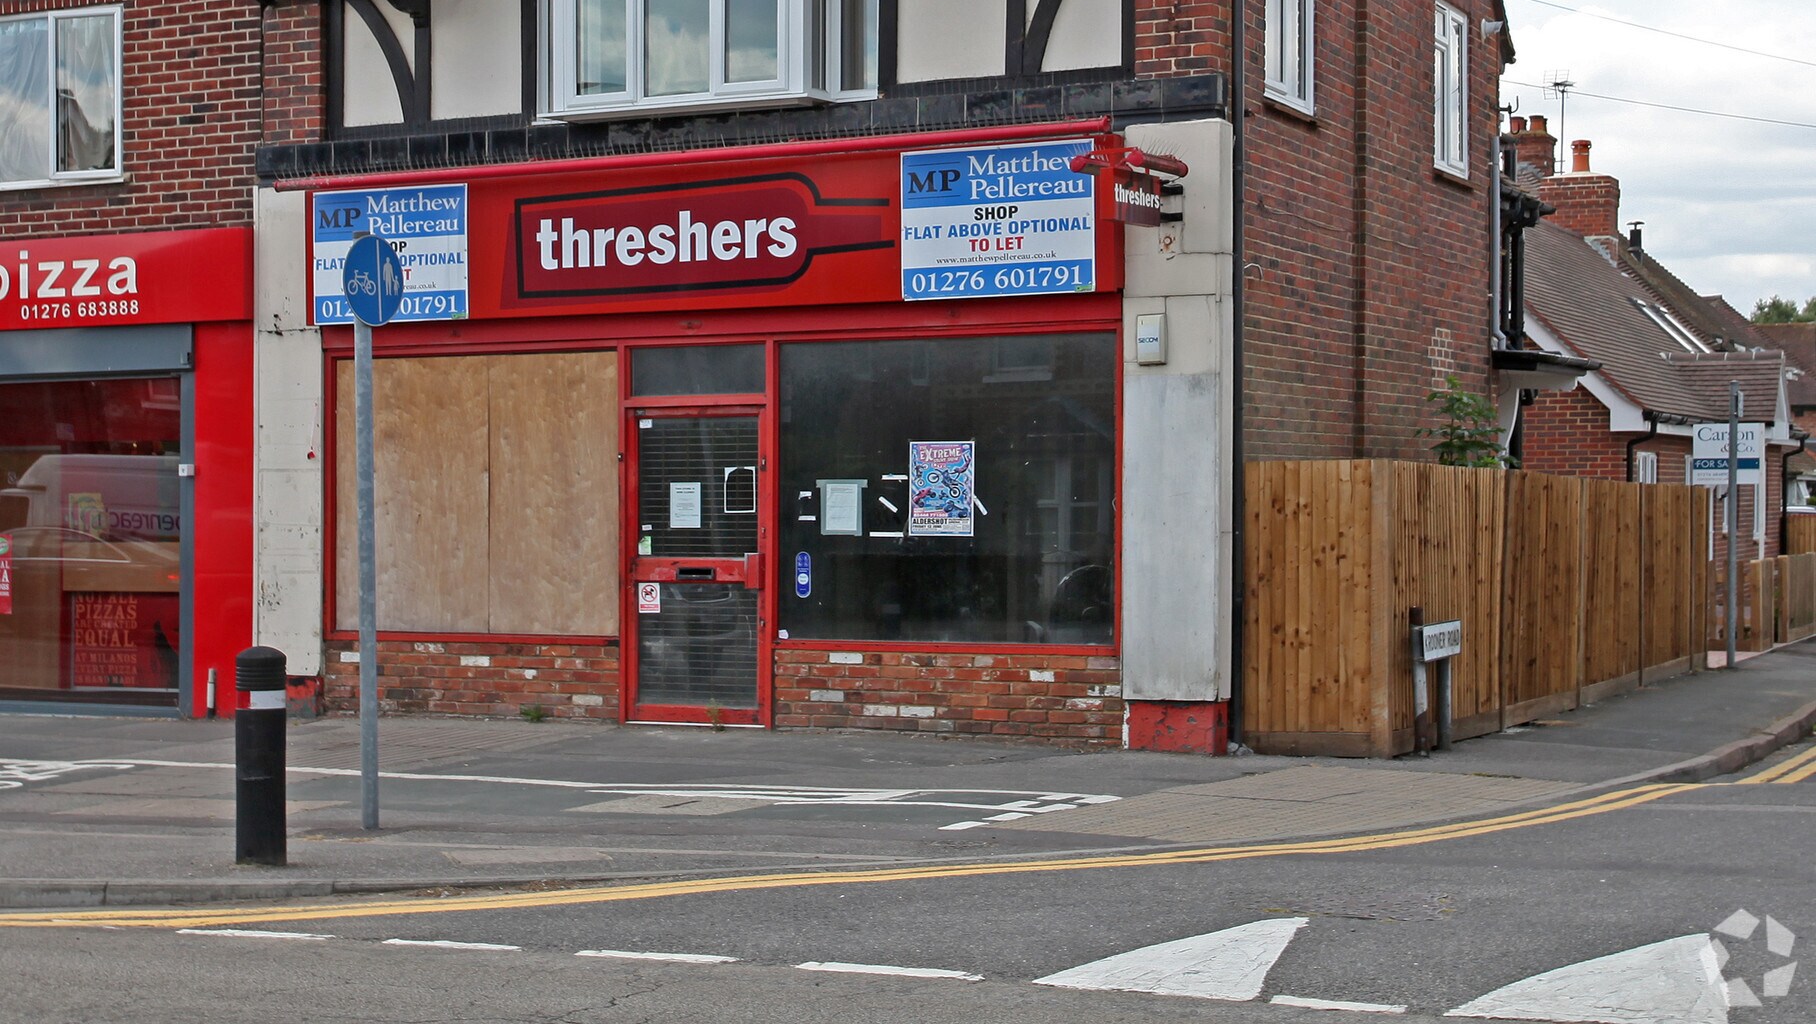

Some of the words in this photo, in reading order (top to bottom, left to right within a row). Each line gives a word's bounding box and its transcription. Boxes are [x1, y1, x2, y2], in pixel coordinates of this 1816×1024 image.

[907, 169, 961, 194] MP
[969, 176, 1086, 200] Pellereau
[366, 192, 461, 215] Matthew
[1114, 183, 1160, 209] threshers
[318, 207, 362, 229] MP
[974, 205, 1019, 221] SHOP
[369, 214, 459, 236] Pellereau
[904, 225, 942, 240] FLAT
[948, 221, 1001, 238] ABOVE
[1008, 216, 1091, 235] OPTIONAL
[536, 210, 797, 270] threshers
[969, 238, 990, 252] TO
[996, 236, 1024, 251] LET
[316, 257, 345, 271] FLAT
[401, 252, 464, 267] OPTIONAL
[936, 250, 1057, 265] www.matthewpellereau.co.uk
[912, 269, 985, 293] 01276
[995, 264, 1082, 289] 601791
[21, 303, 71, 320] 01276
[78, 299, 139, 318] 683888
[322, 299, 355, 318] 012
[400, 295, 458, 315] 01791
[1697, 426, 1755, 442] Caron
[920, 447, 961, 462] EXTREME
[1696, 460, 1715, 468] FOR
[1717, 459, 1729, 468] SA
[75, 604, 137, 620] PIZZAS
